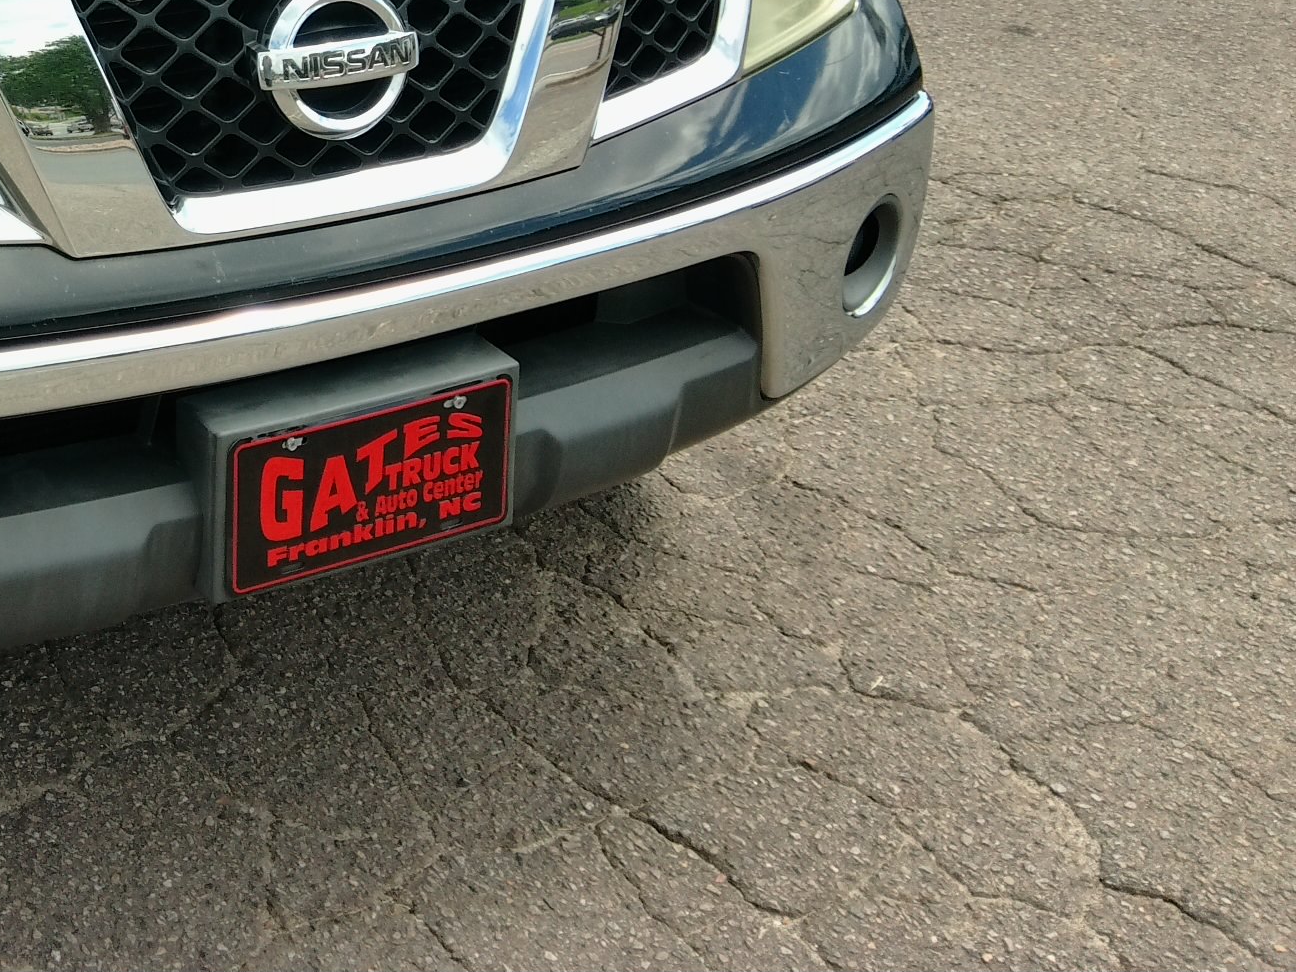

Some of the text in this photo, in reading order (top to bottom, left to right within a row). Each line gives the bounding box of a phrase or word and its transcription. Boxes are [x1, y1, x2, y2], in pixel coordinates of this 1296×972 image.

[282, 35, 415, 82] NISSAN
[259, 412, 483, 542] GATES
[385, 441, 481, 490] TRUCK
[355, 469, 483, 522] & Auto Center
[266, 491, 482, 568] Franklin, NC
